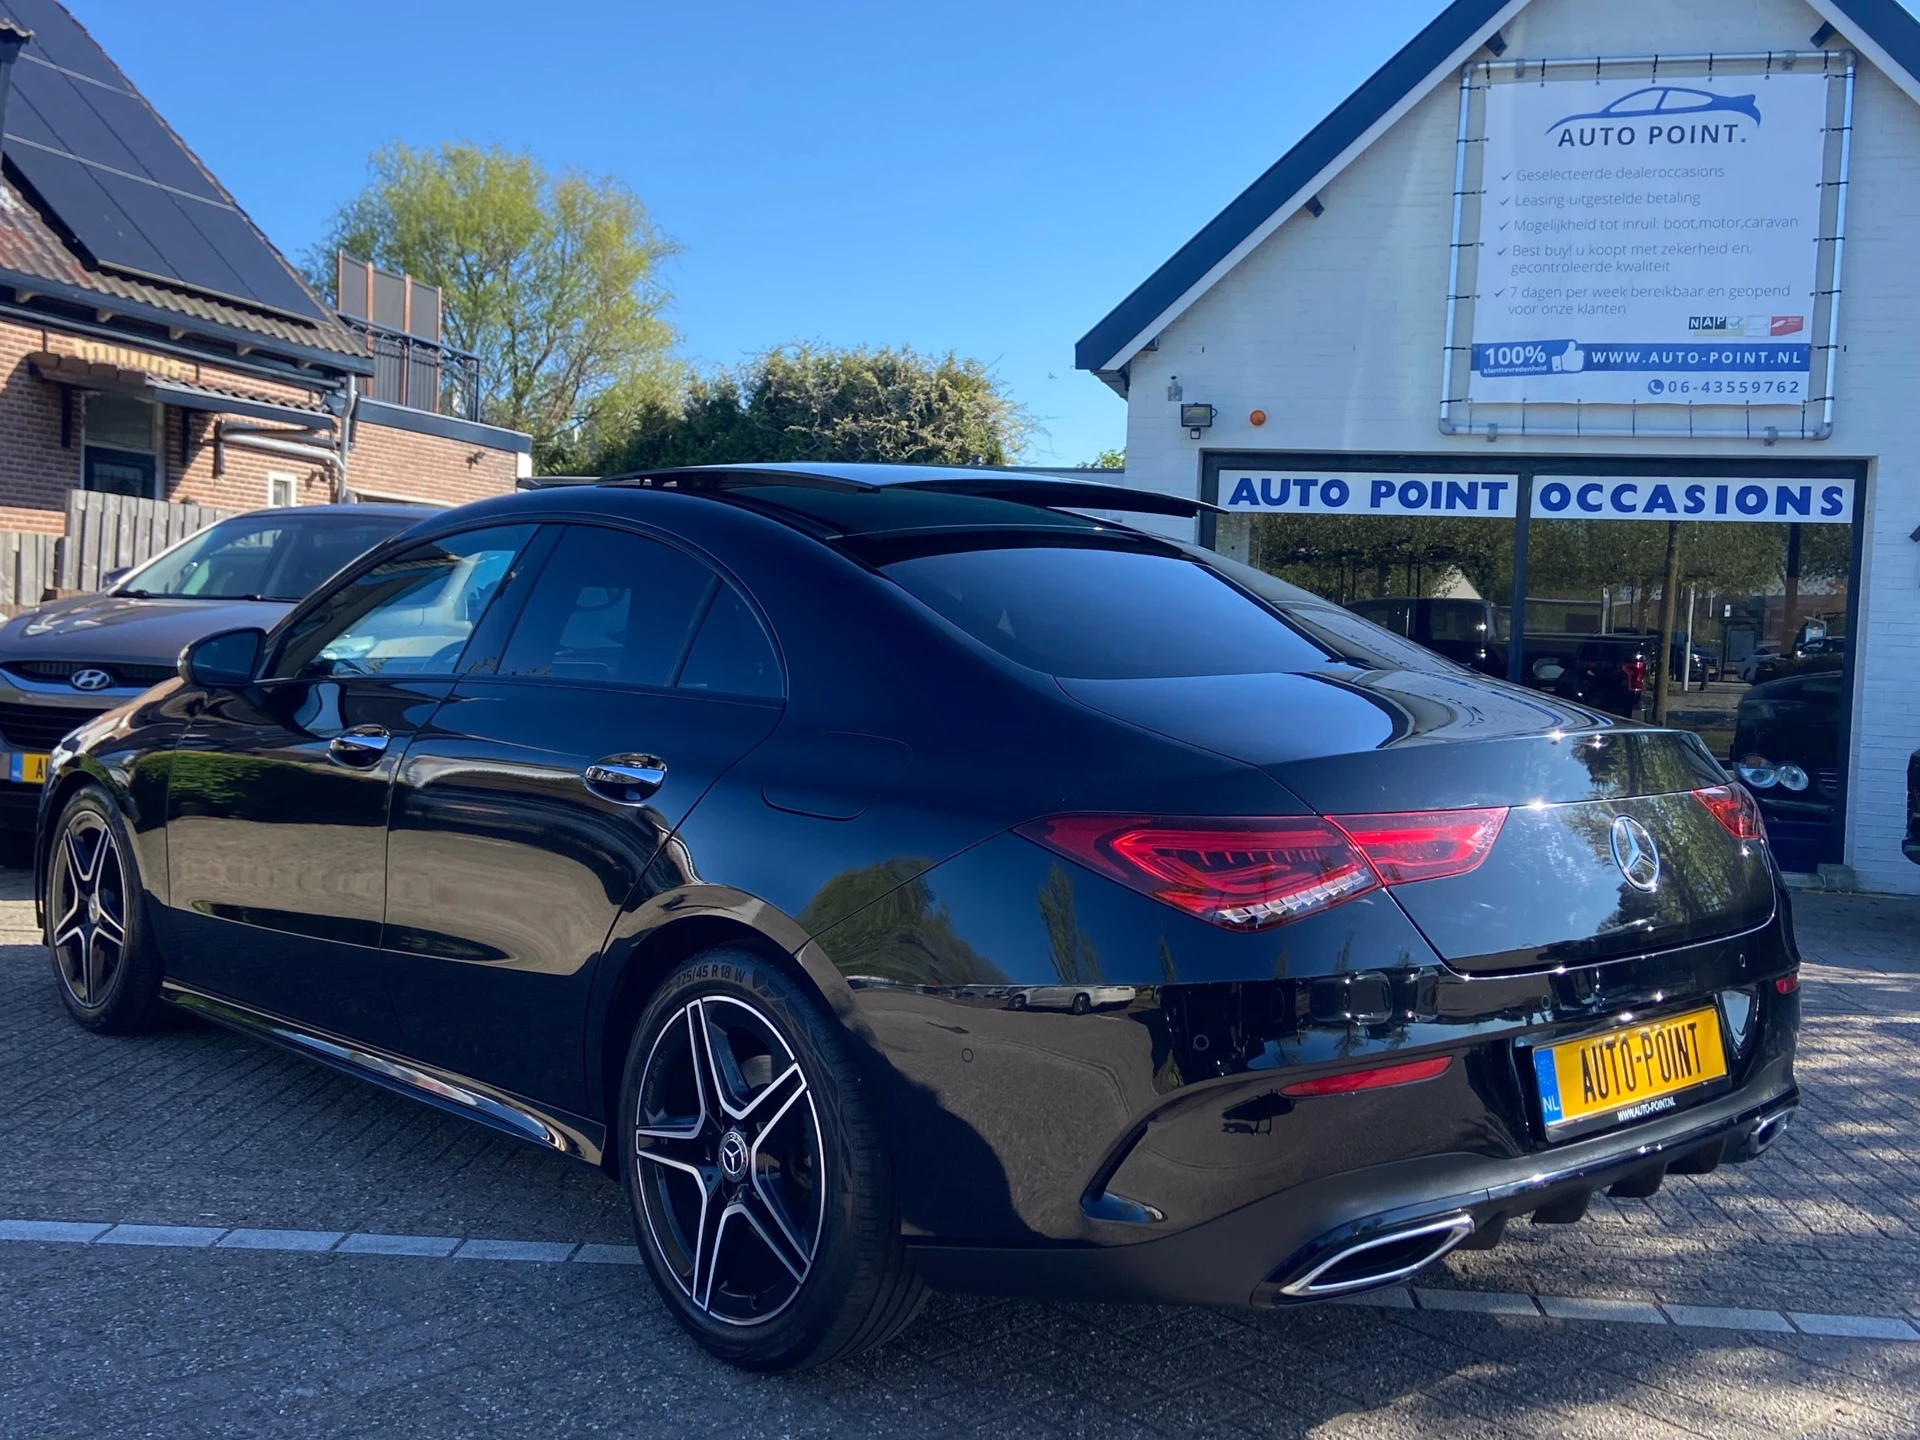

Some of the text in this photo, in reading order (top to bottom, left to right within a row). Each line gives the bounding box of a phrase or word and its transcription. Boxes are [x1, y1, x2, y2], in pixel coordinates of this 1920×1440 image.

[1558, 126, 1636, 147] AUTO
[1516, 166, 1724, 181] Geselecteerde dealeroccasions
[1515, 192, 1700, 209] Leasing-uitgestelde betaling
[1514, 218, 1596, 234] Mogelijkheid
[1600, 219, 1618, 230] tot
[1623, 218, 1660, 230] inruil:
[1512, 245, 1540, 257] Best
[1545, 244, 1572, 259] buy!
[1576, 247, 1584, 256] u
[1589, 243, 1626, 258] koopt
[1631, 245, 1657, 255] met
[1661, 243, 1728, 255] zekerheid
[1511, 260, 1670, 276] gecontroleerde kwaliteit
[1510, 285, 1790, 301] 7 dagen per week bereikbaar en geopend
[1508, 302, 1626, 315] voor onze klanten
[1690, 316, 1725, 329] NAP
[1485, 345, 1546, 365] 100%
[1591, 350, 1801, 364] WWW.AUTO-POINT.NL
[1668, 380, 1798, 394] 06-43559762
[1228, 478, 1509, 510] AUTO POINT
[1539, 482, 1843, 516] OCCASIONS
[1580, 1022, 1701, 1104] AUTO-POINT
[1543, 1097, 1560, 1113] NL
